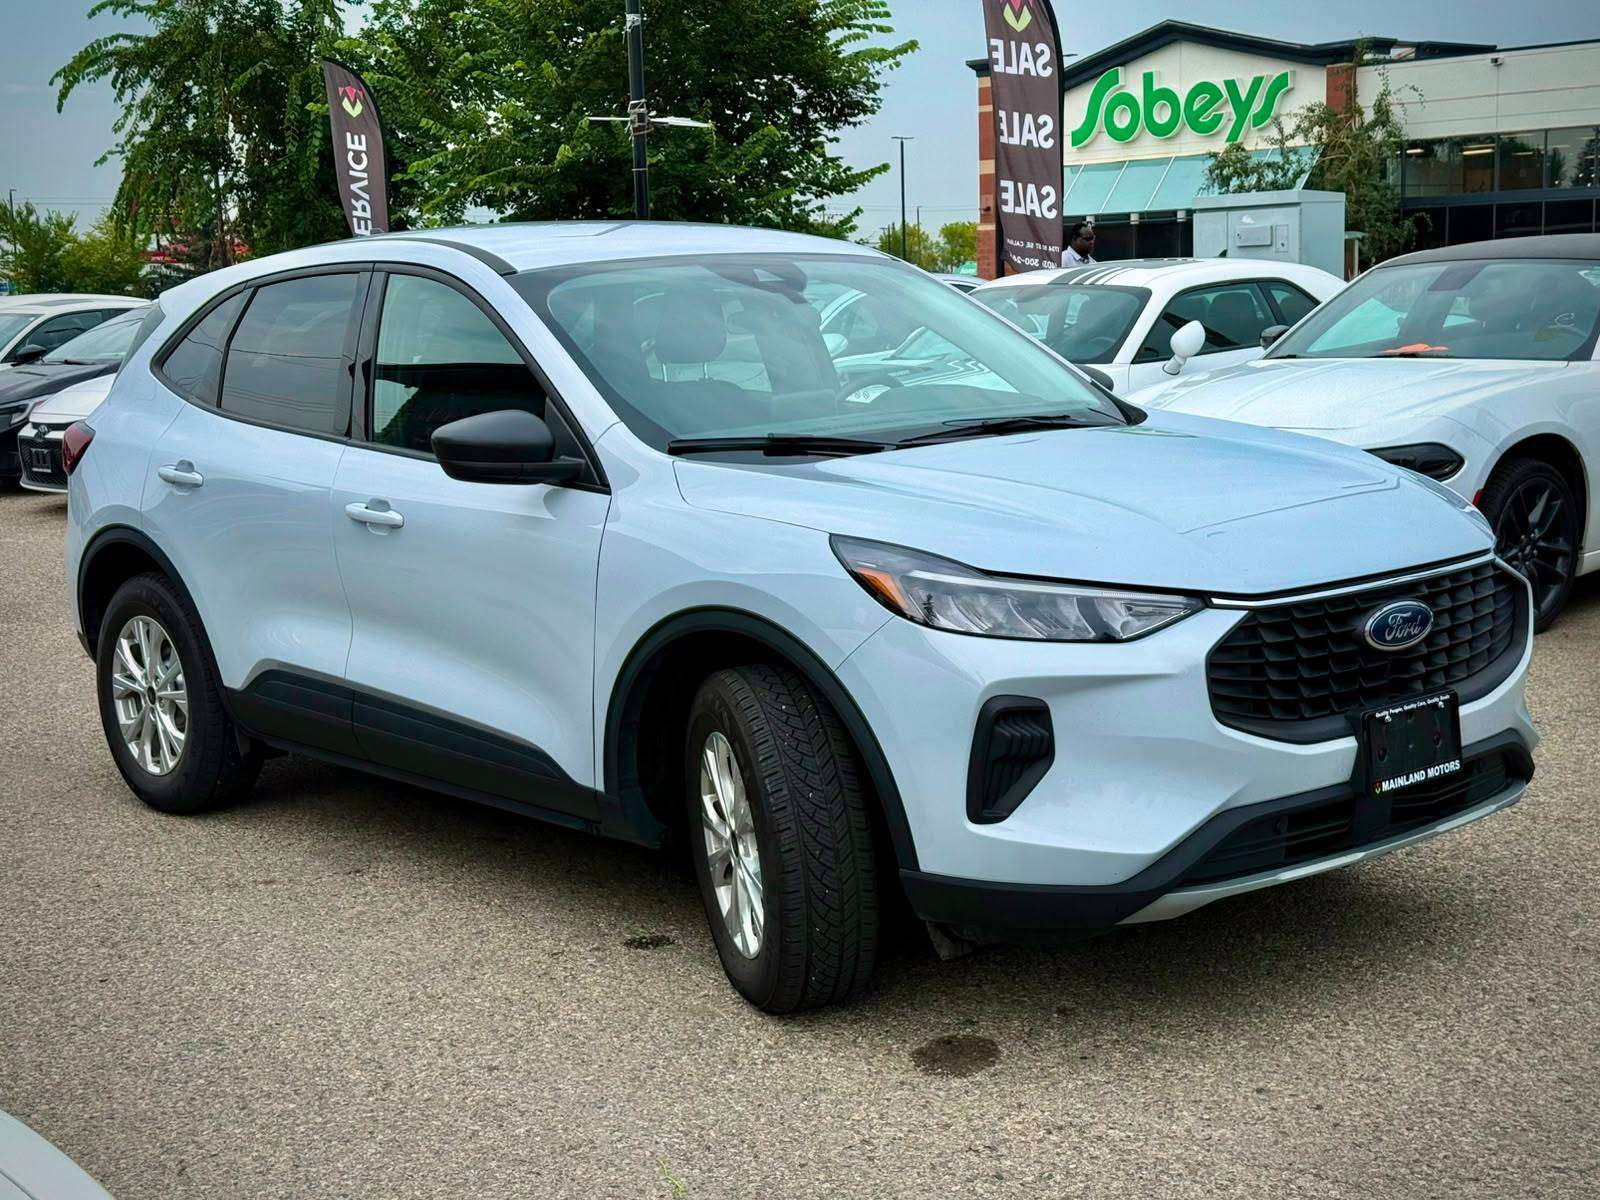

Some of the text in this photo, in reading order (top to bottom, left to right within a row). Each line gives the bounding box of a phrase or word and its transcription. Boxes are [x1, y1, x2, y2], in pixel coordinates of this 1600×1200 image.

[1071, 67, 1293, 148] Sobeys
[1385, 612, 1424, 641] Ford
[1382, 760, 1461, 792] MAINLAND MOTORS
